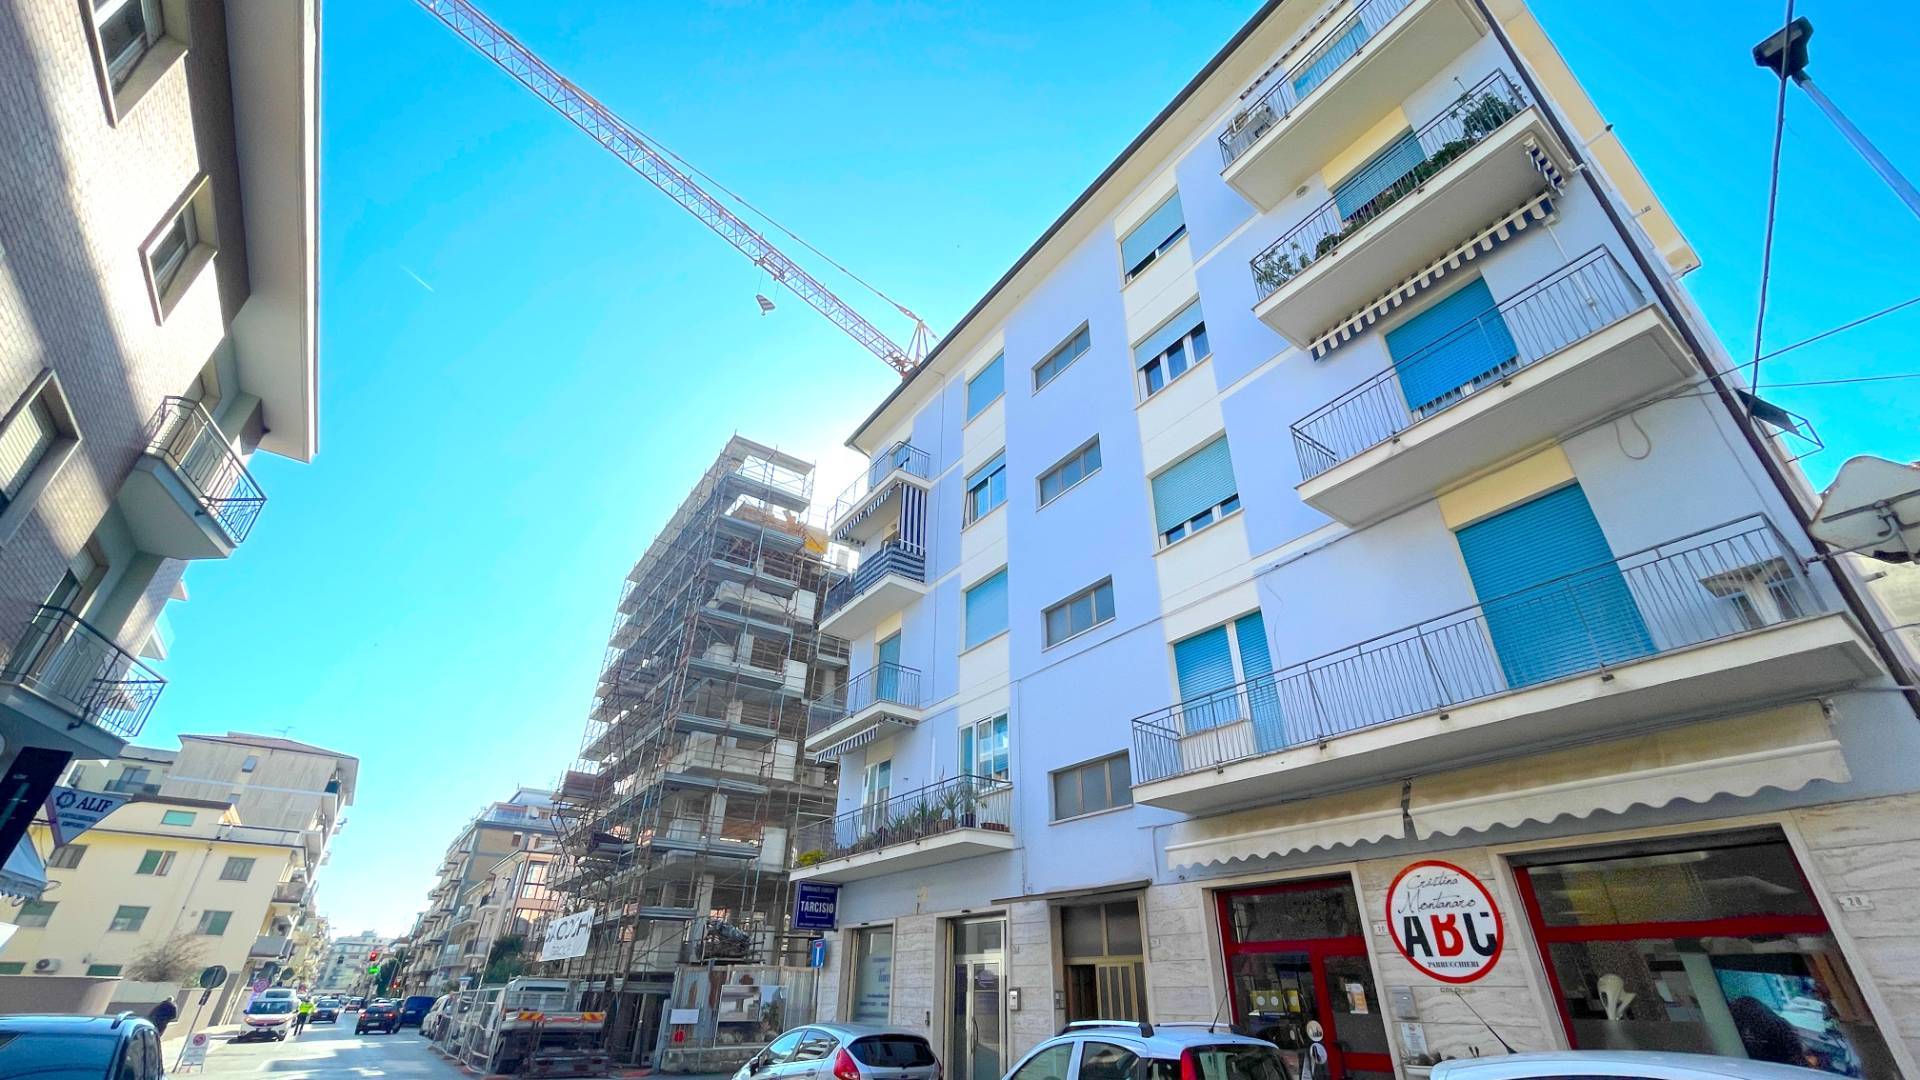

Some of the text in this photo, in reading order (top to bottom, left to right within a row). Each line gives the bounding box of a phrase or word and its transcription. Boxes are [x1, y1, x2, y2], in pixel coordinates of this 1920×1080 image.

[76, 797, 113, 812] ALIF
[800, 900, 834, 914] TARCISIO
[1397, 889, 1477, 914] Montanaro
